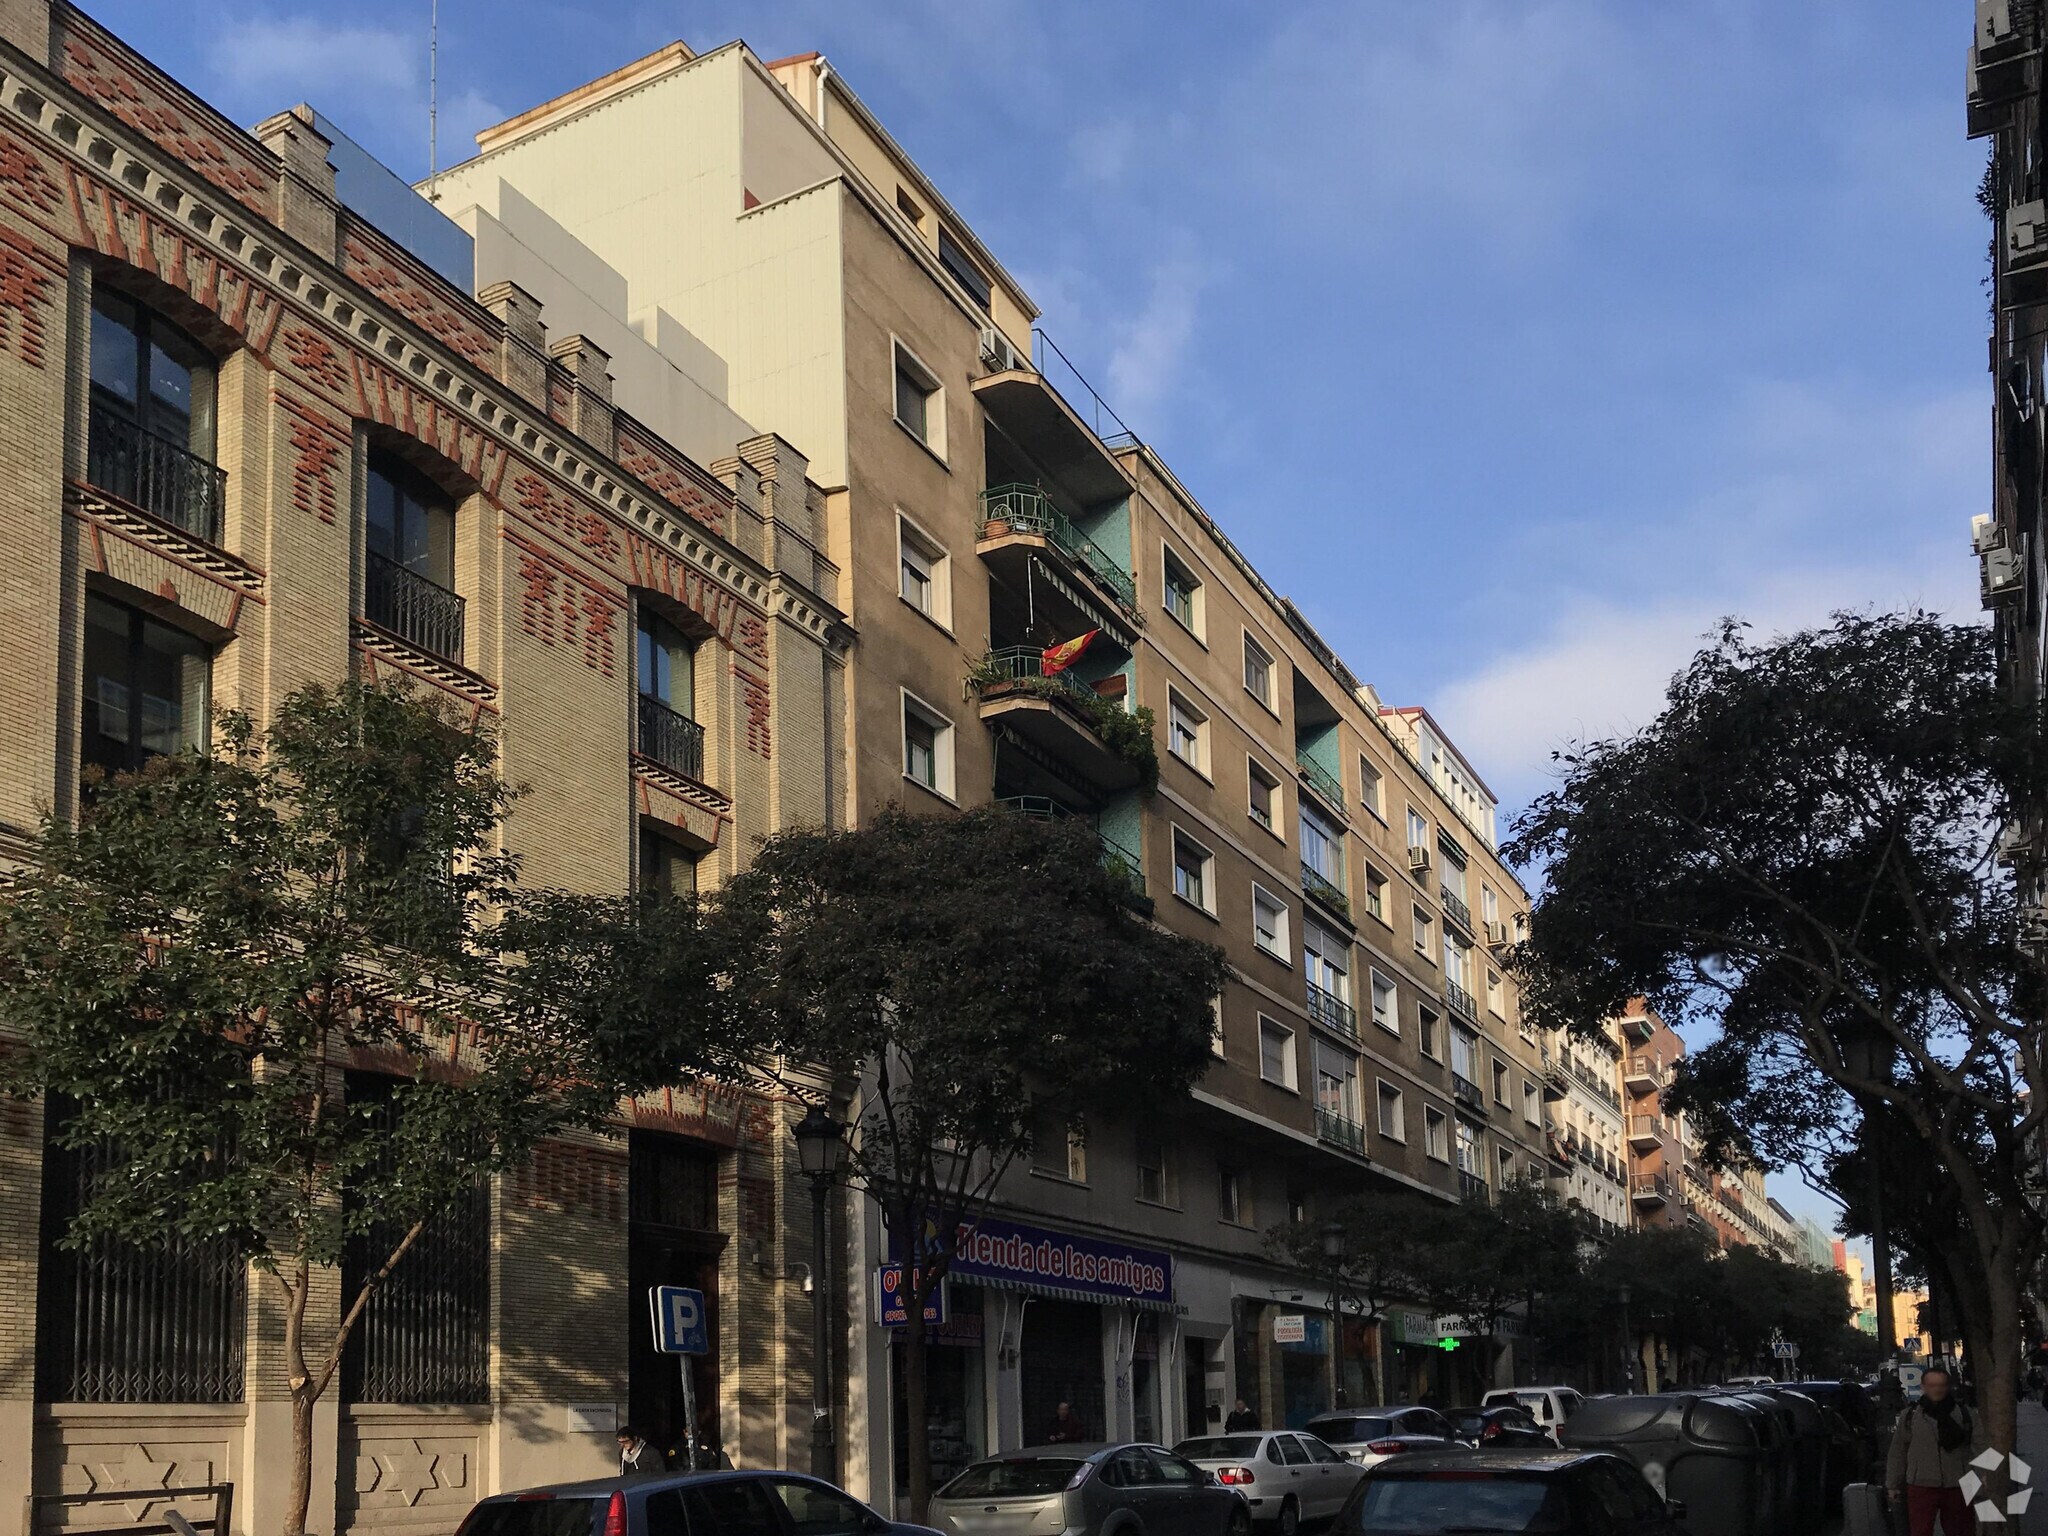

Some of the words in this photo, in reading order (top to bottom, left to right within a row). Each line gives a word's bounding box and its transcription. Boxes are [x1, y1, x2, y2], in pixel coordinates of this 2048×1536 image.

[956, 1222, 1034, 1273] Tienda
[1036, 1239, 1063, 1277] de
[1065, 1244, 1097, 1282] las
[1098, 1254, 1165, 1294] amigas
[672, 1295, 699, 1344] P
[885, 1308, 937, 1321] OPORTDES
[1441, 1320, 1489, 1333] FARMIA
